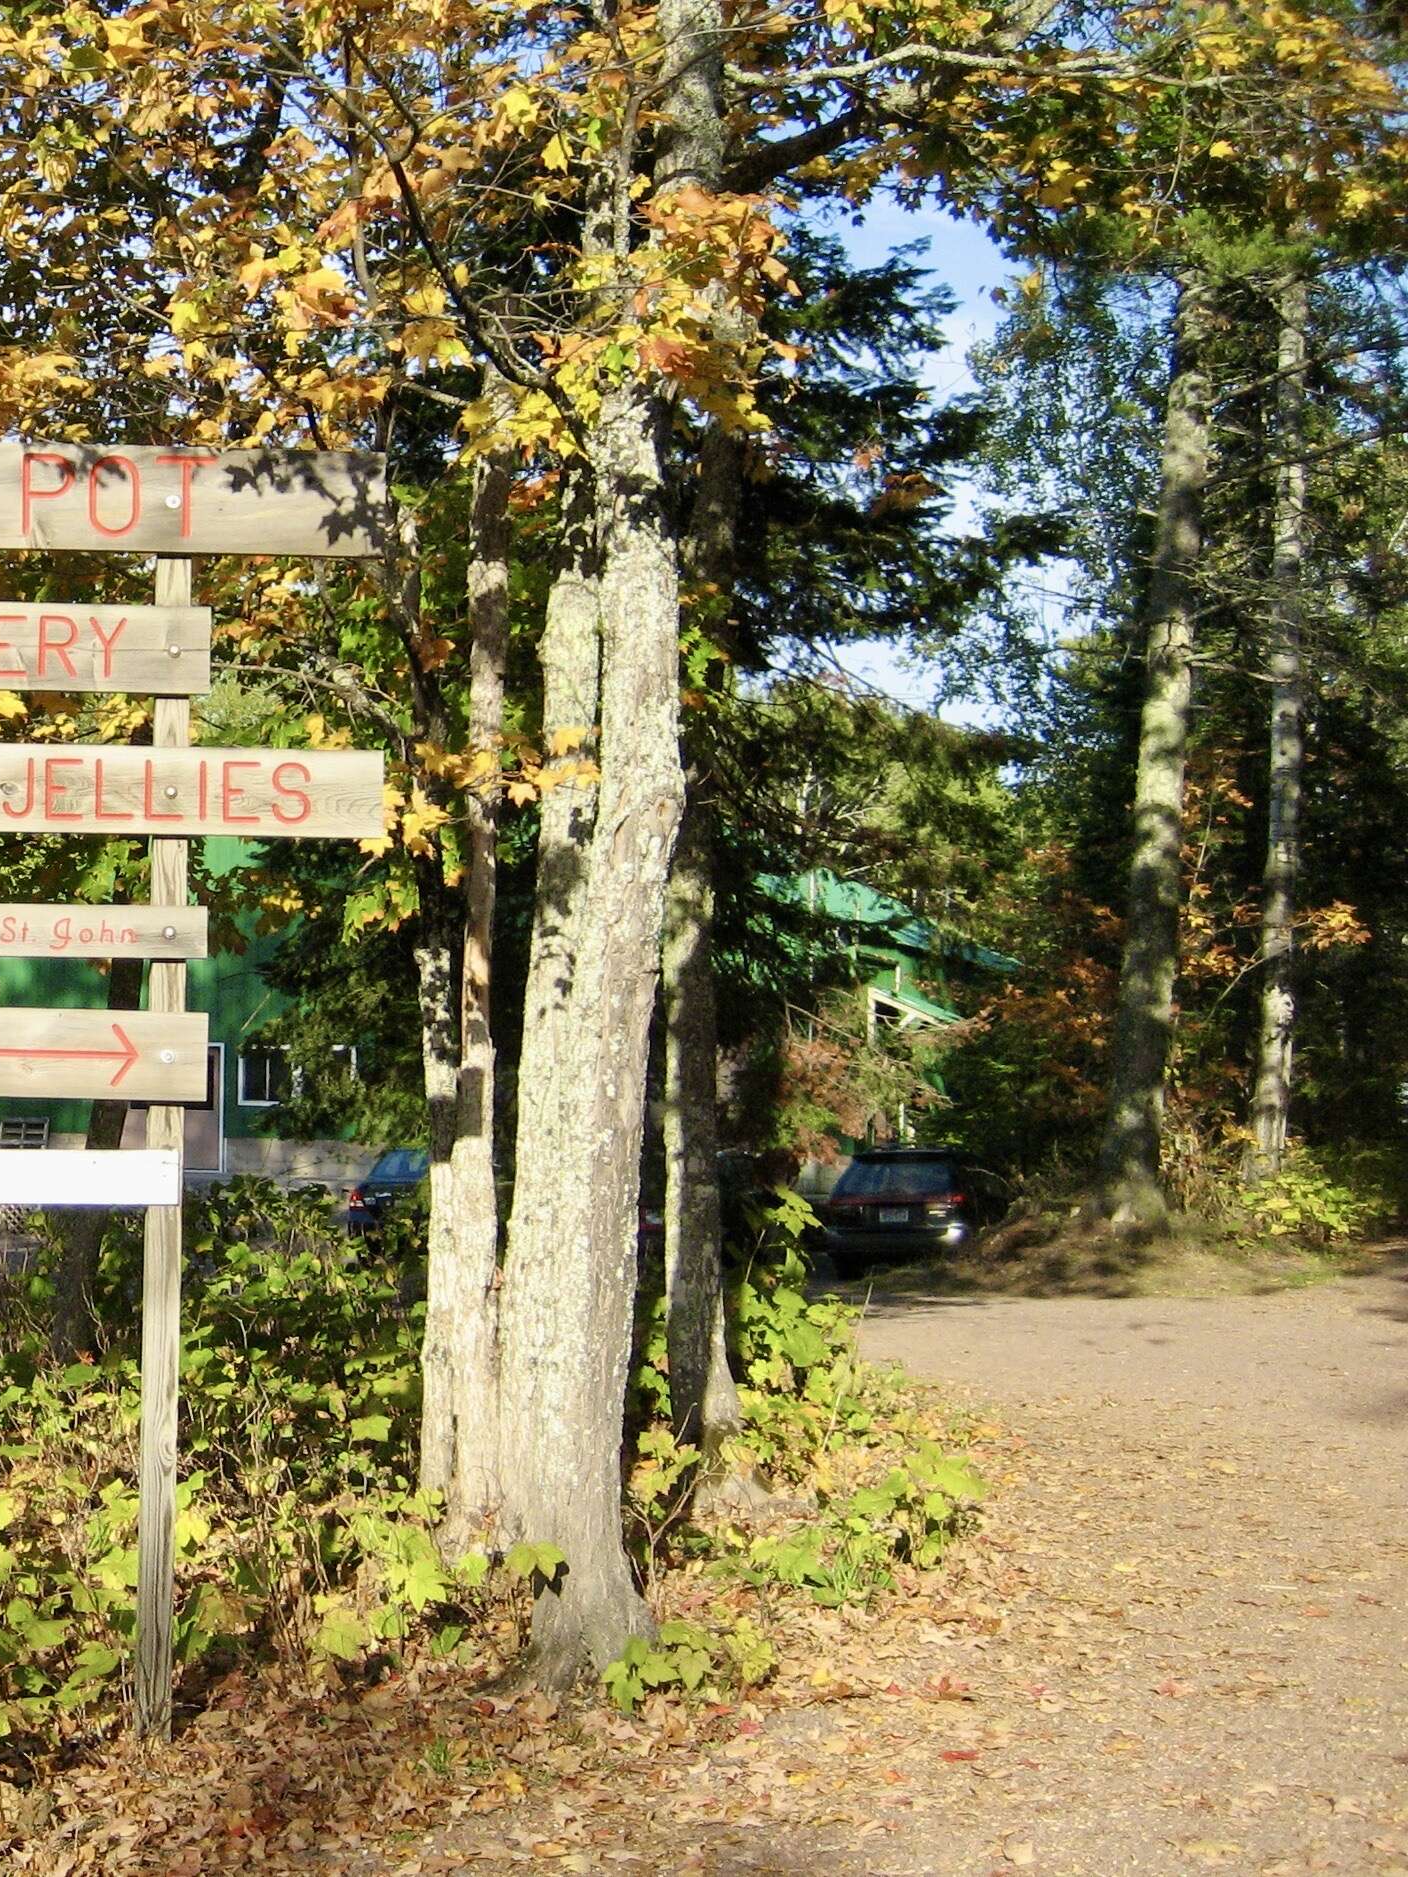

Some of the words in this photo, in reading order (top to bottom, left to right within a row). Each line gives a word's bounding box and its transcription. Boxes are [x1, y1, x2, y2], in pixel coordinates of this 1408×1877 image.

[20, 452, 220, 539] POT
[1, 757, 312, 826] JELLIES
[0, 916, 35, 945] St.
[49, 917, 141, 951] John
